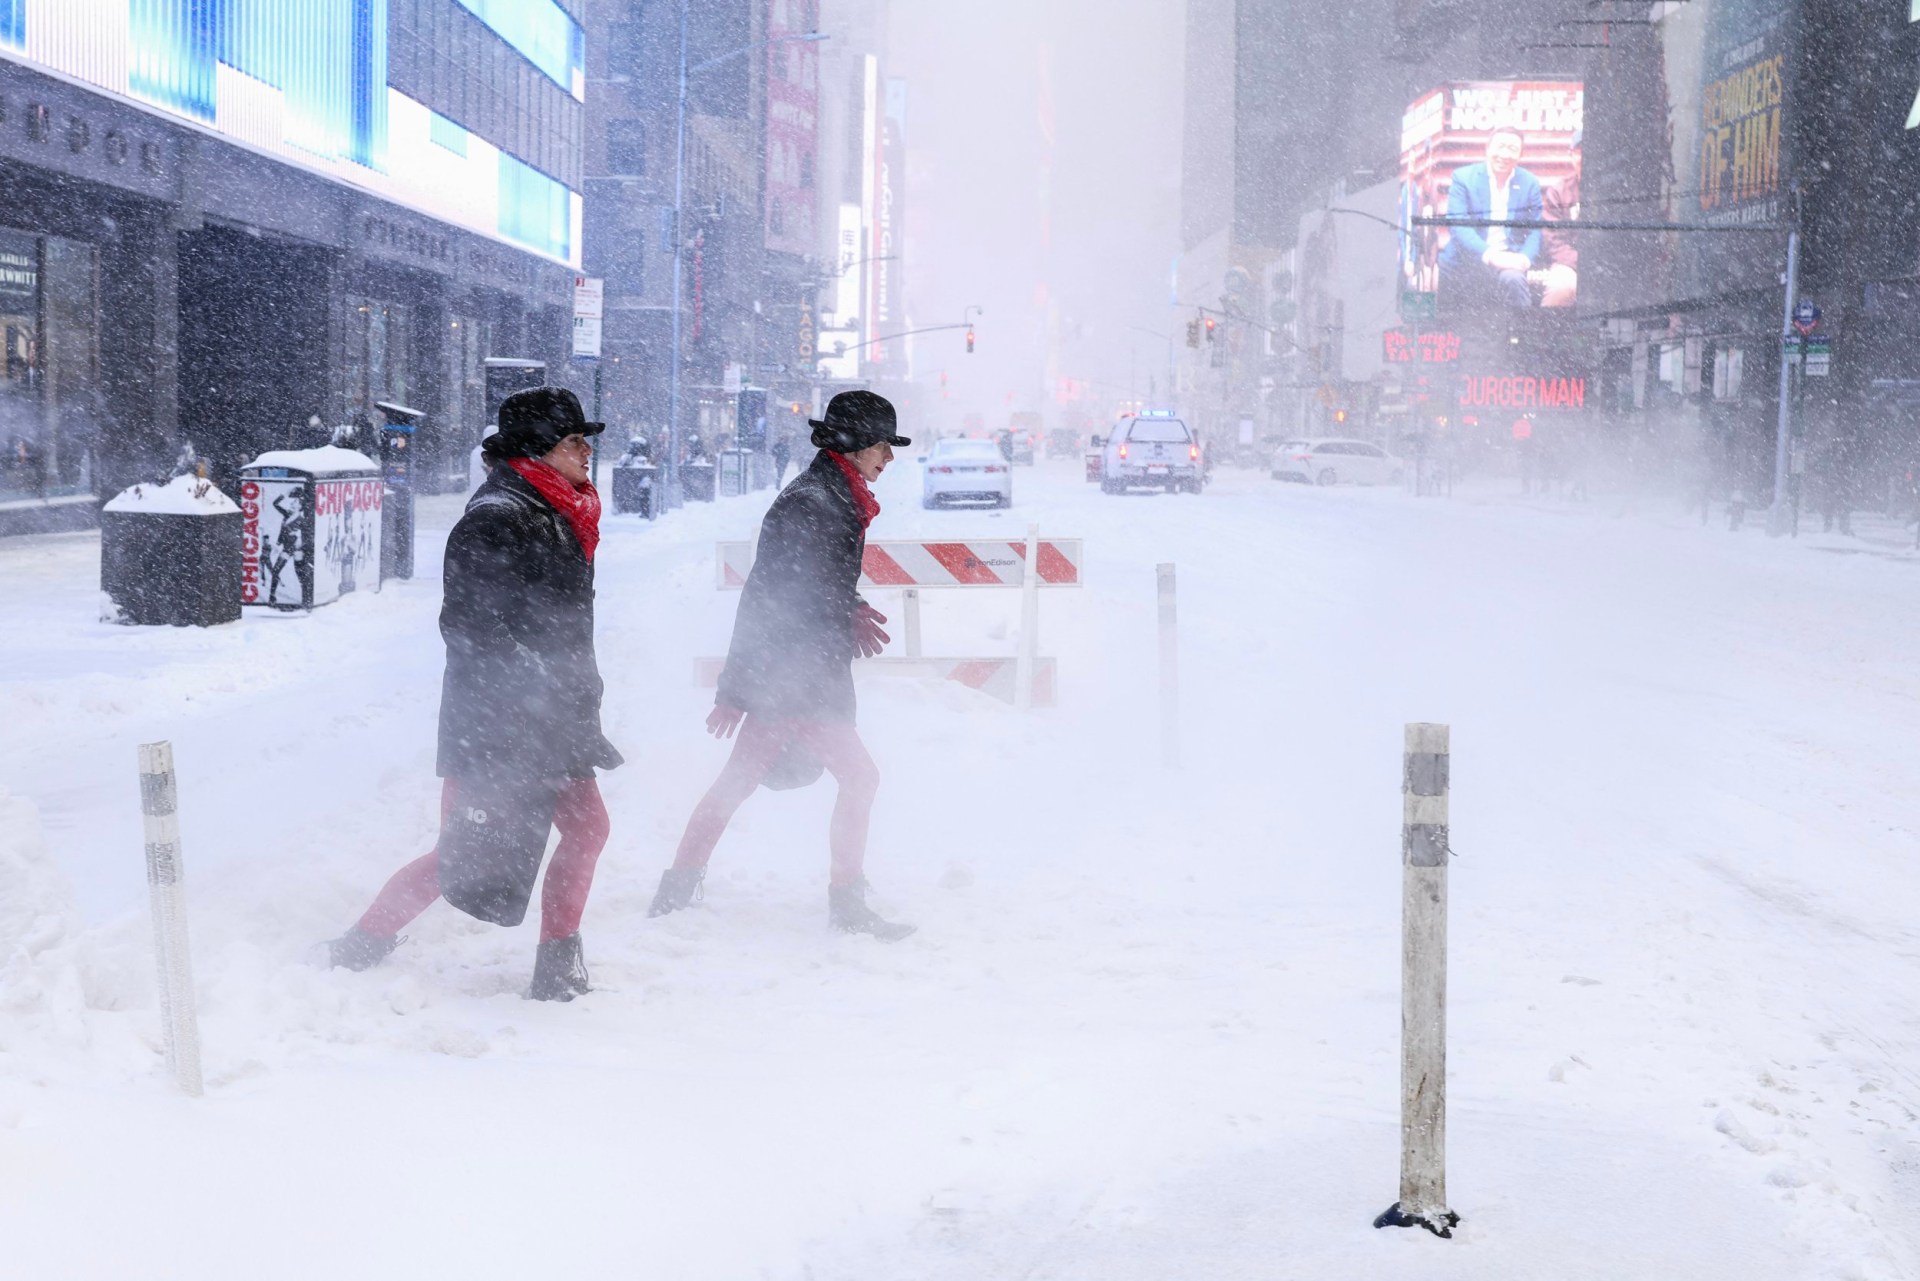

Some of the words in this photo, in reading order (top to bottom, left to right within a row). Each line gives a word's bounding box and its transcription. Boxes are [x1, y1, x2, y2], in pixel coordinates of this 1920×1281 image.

[1510, 90, 1568, 108] JUST
[1702, 55, 1783, 127] REMINDERS
[1699, 127, 1730, 210] OF
[1732, 108, 1781, 205] HIM
[1539, 376, 1584, 409] MAN
[314, 481, 382, 516] CHICAGO
[242, 482, 260, 603] CHICAGO
